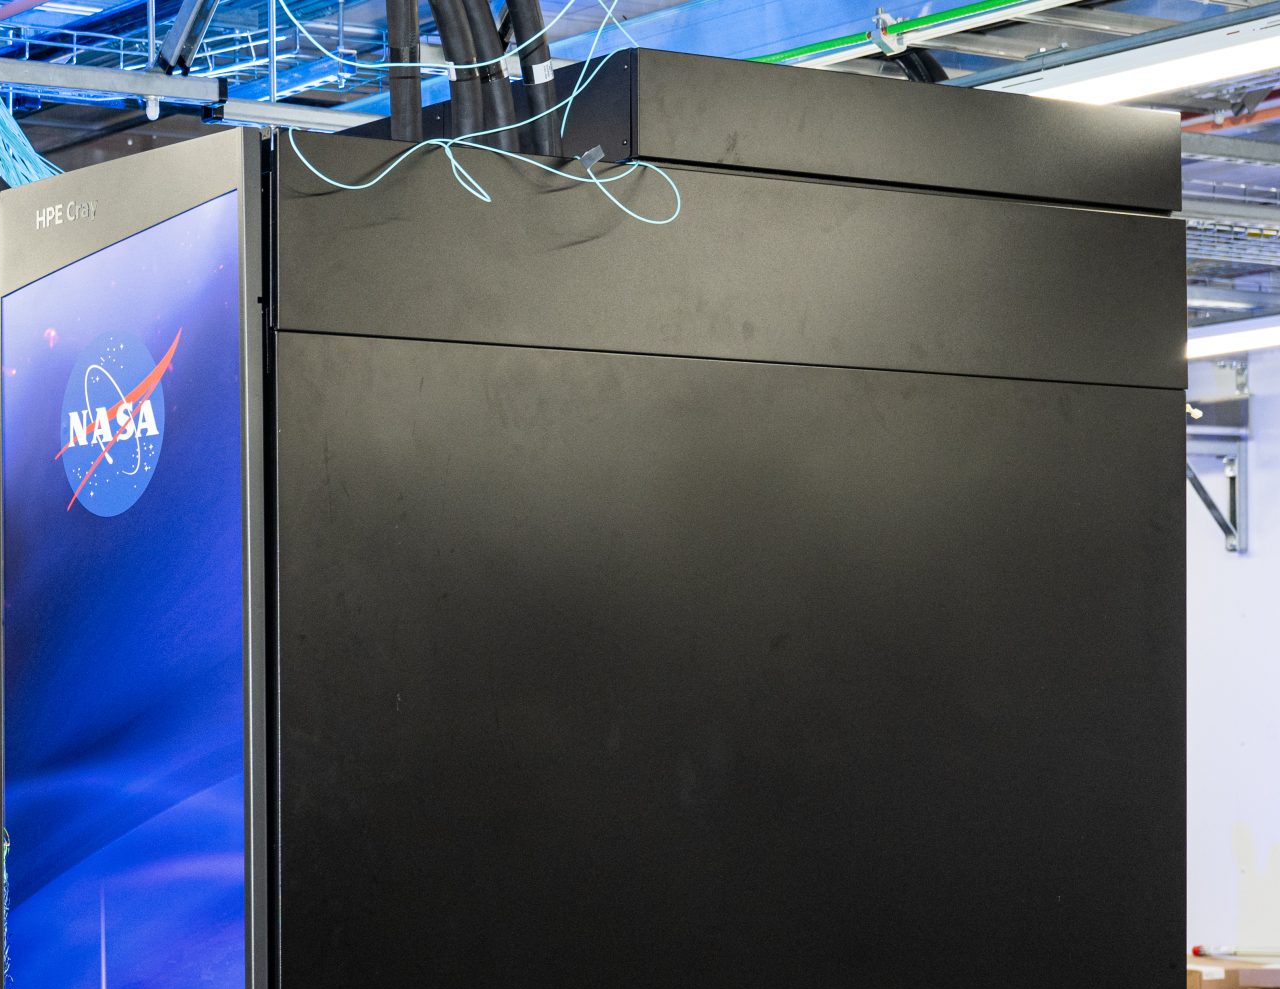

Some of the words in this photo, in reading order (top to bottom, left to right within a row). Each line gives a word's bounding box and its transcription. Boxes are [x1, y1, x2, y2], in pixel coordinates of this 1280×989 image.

[35, 202, 63, 230] HPE
[66, 199, 99, 222] Cray
[68, 399, 160, 448] NASA
